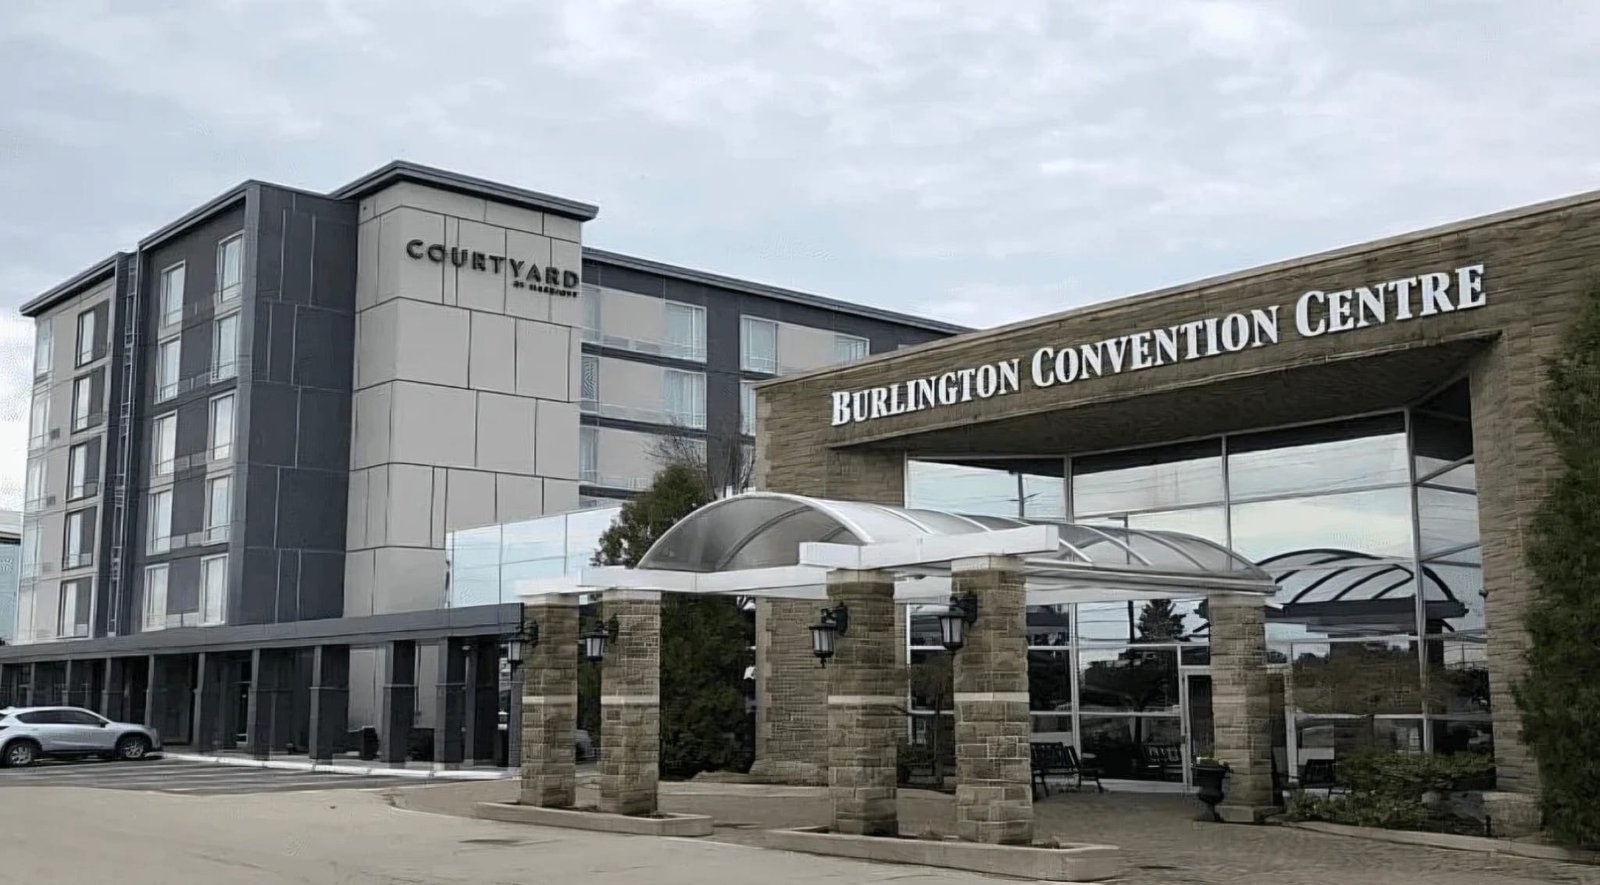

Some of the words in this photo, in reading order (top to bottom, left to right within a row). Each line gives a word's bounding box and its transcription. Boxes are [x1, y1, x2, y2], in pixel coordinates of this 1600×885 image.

[406, 239, 579, 289] COURTYARD
[831, 358, 1020, 427] BURLINGTON
[1031, 305, 1281, 387] CONVENTION
[1295, 264, 1487, 338] CENTRE
